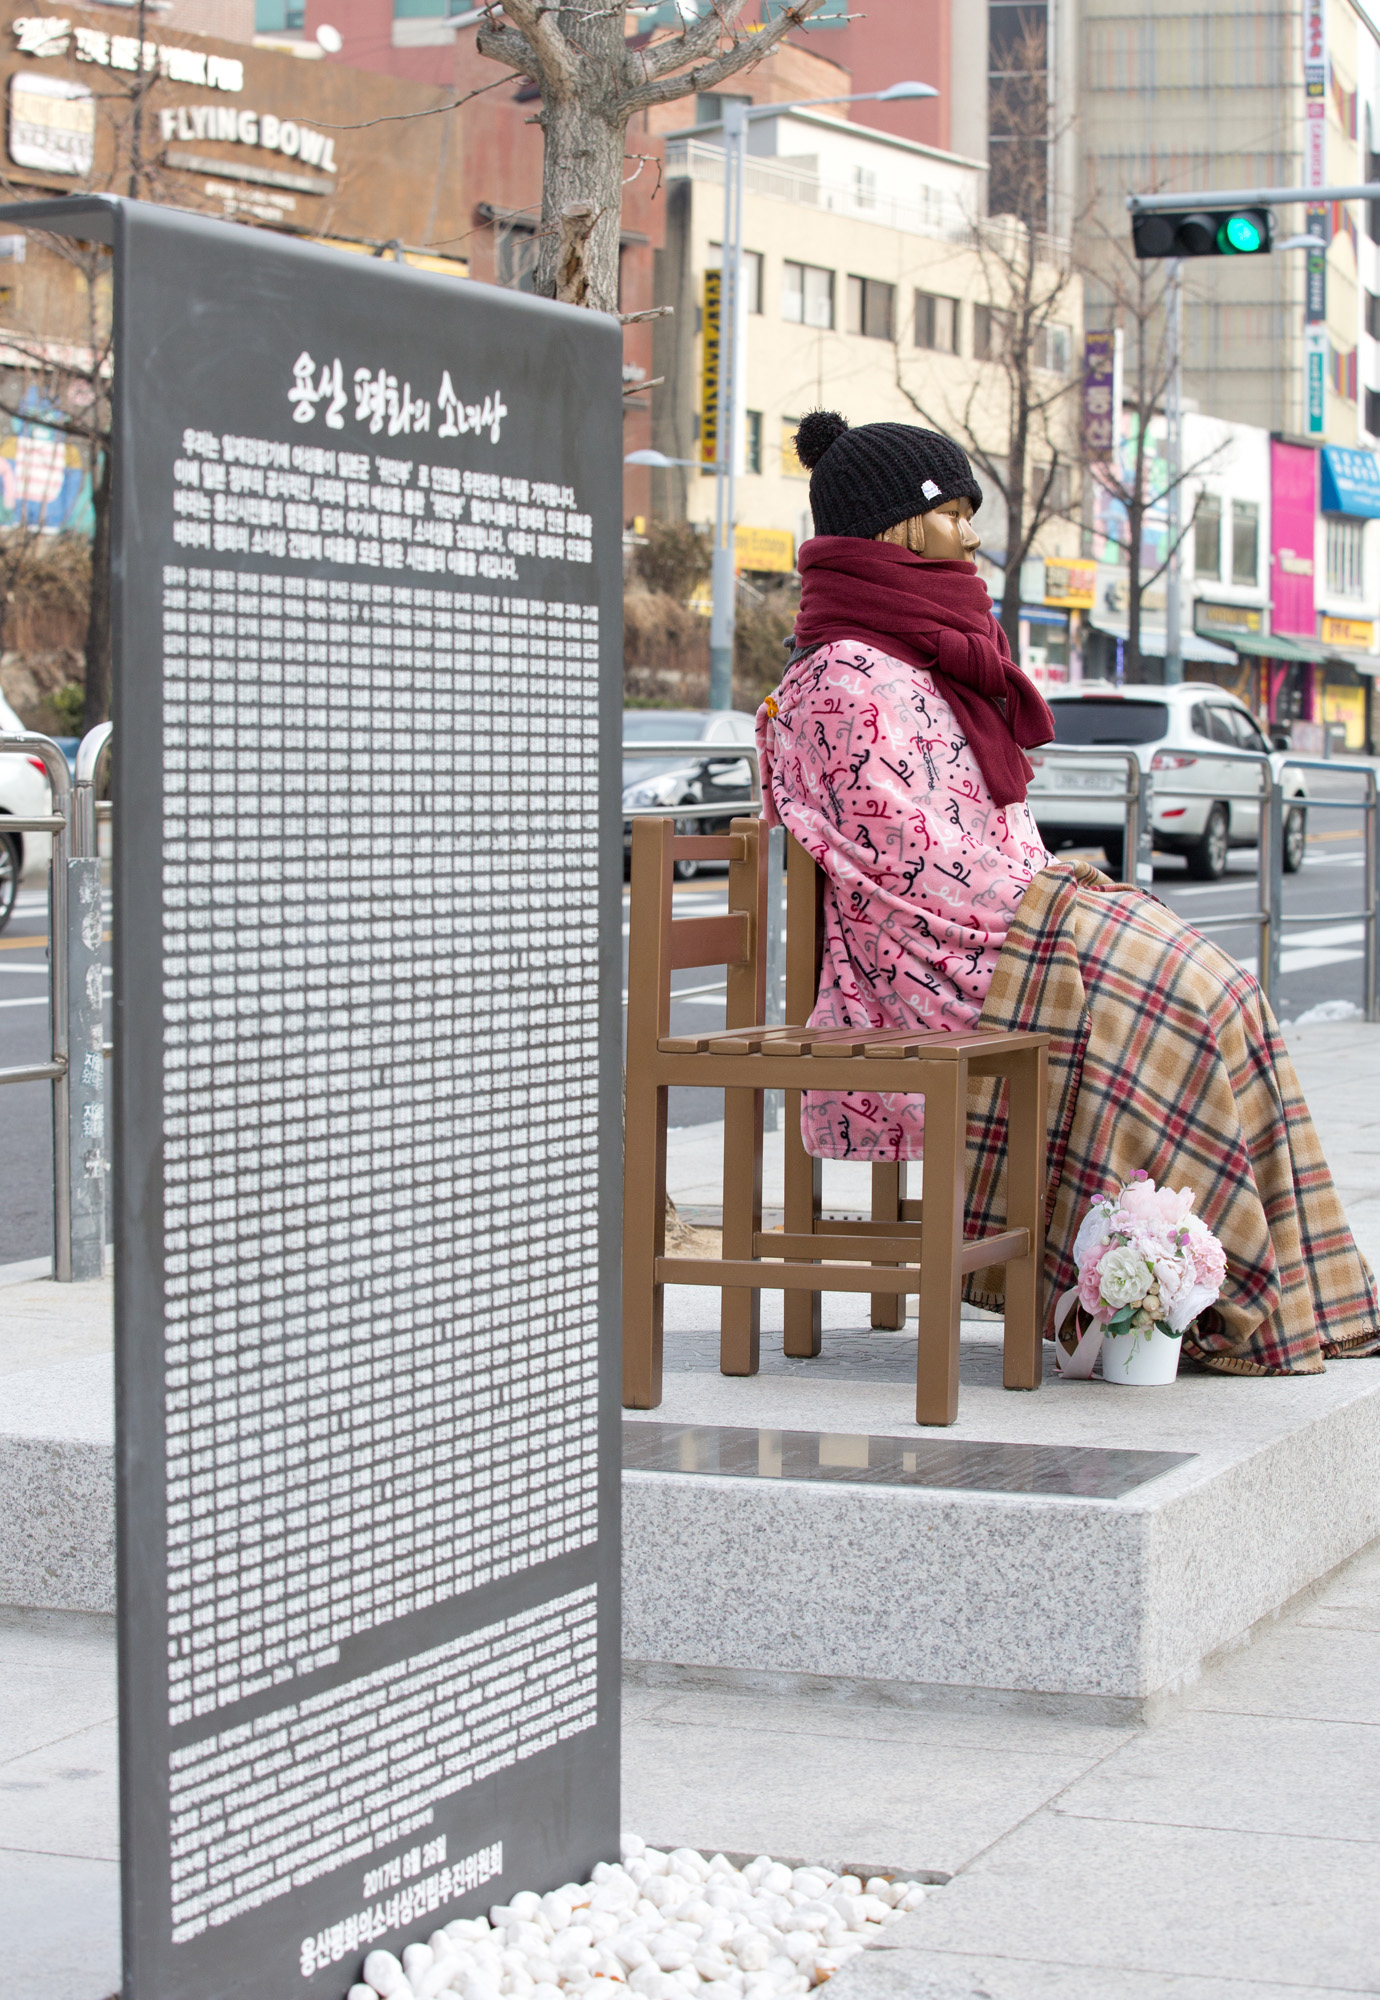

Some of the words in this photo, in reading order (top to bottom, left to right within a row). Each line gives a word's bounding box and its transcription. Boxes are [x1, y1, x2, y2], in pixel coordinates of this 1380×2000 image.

[159, 105, 259, 145] FLYING
[260, 114, 338, 173] BOWL
[353, 367, 431, 437] 평화의
[437, 369, 508, 445] 소녀상
[363, 1856, 401, 1899] 2017년
[402, 1846, 421, 1878] 8월
[422, 1833, 447, 1869] 26일
[299, 1840, 503, 1978] 용산평화의소녀상건립추진위원회
